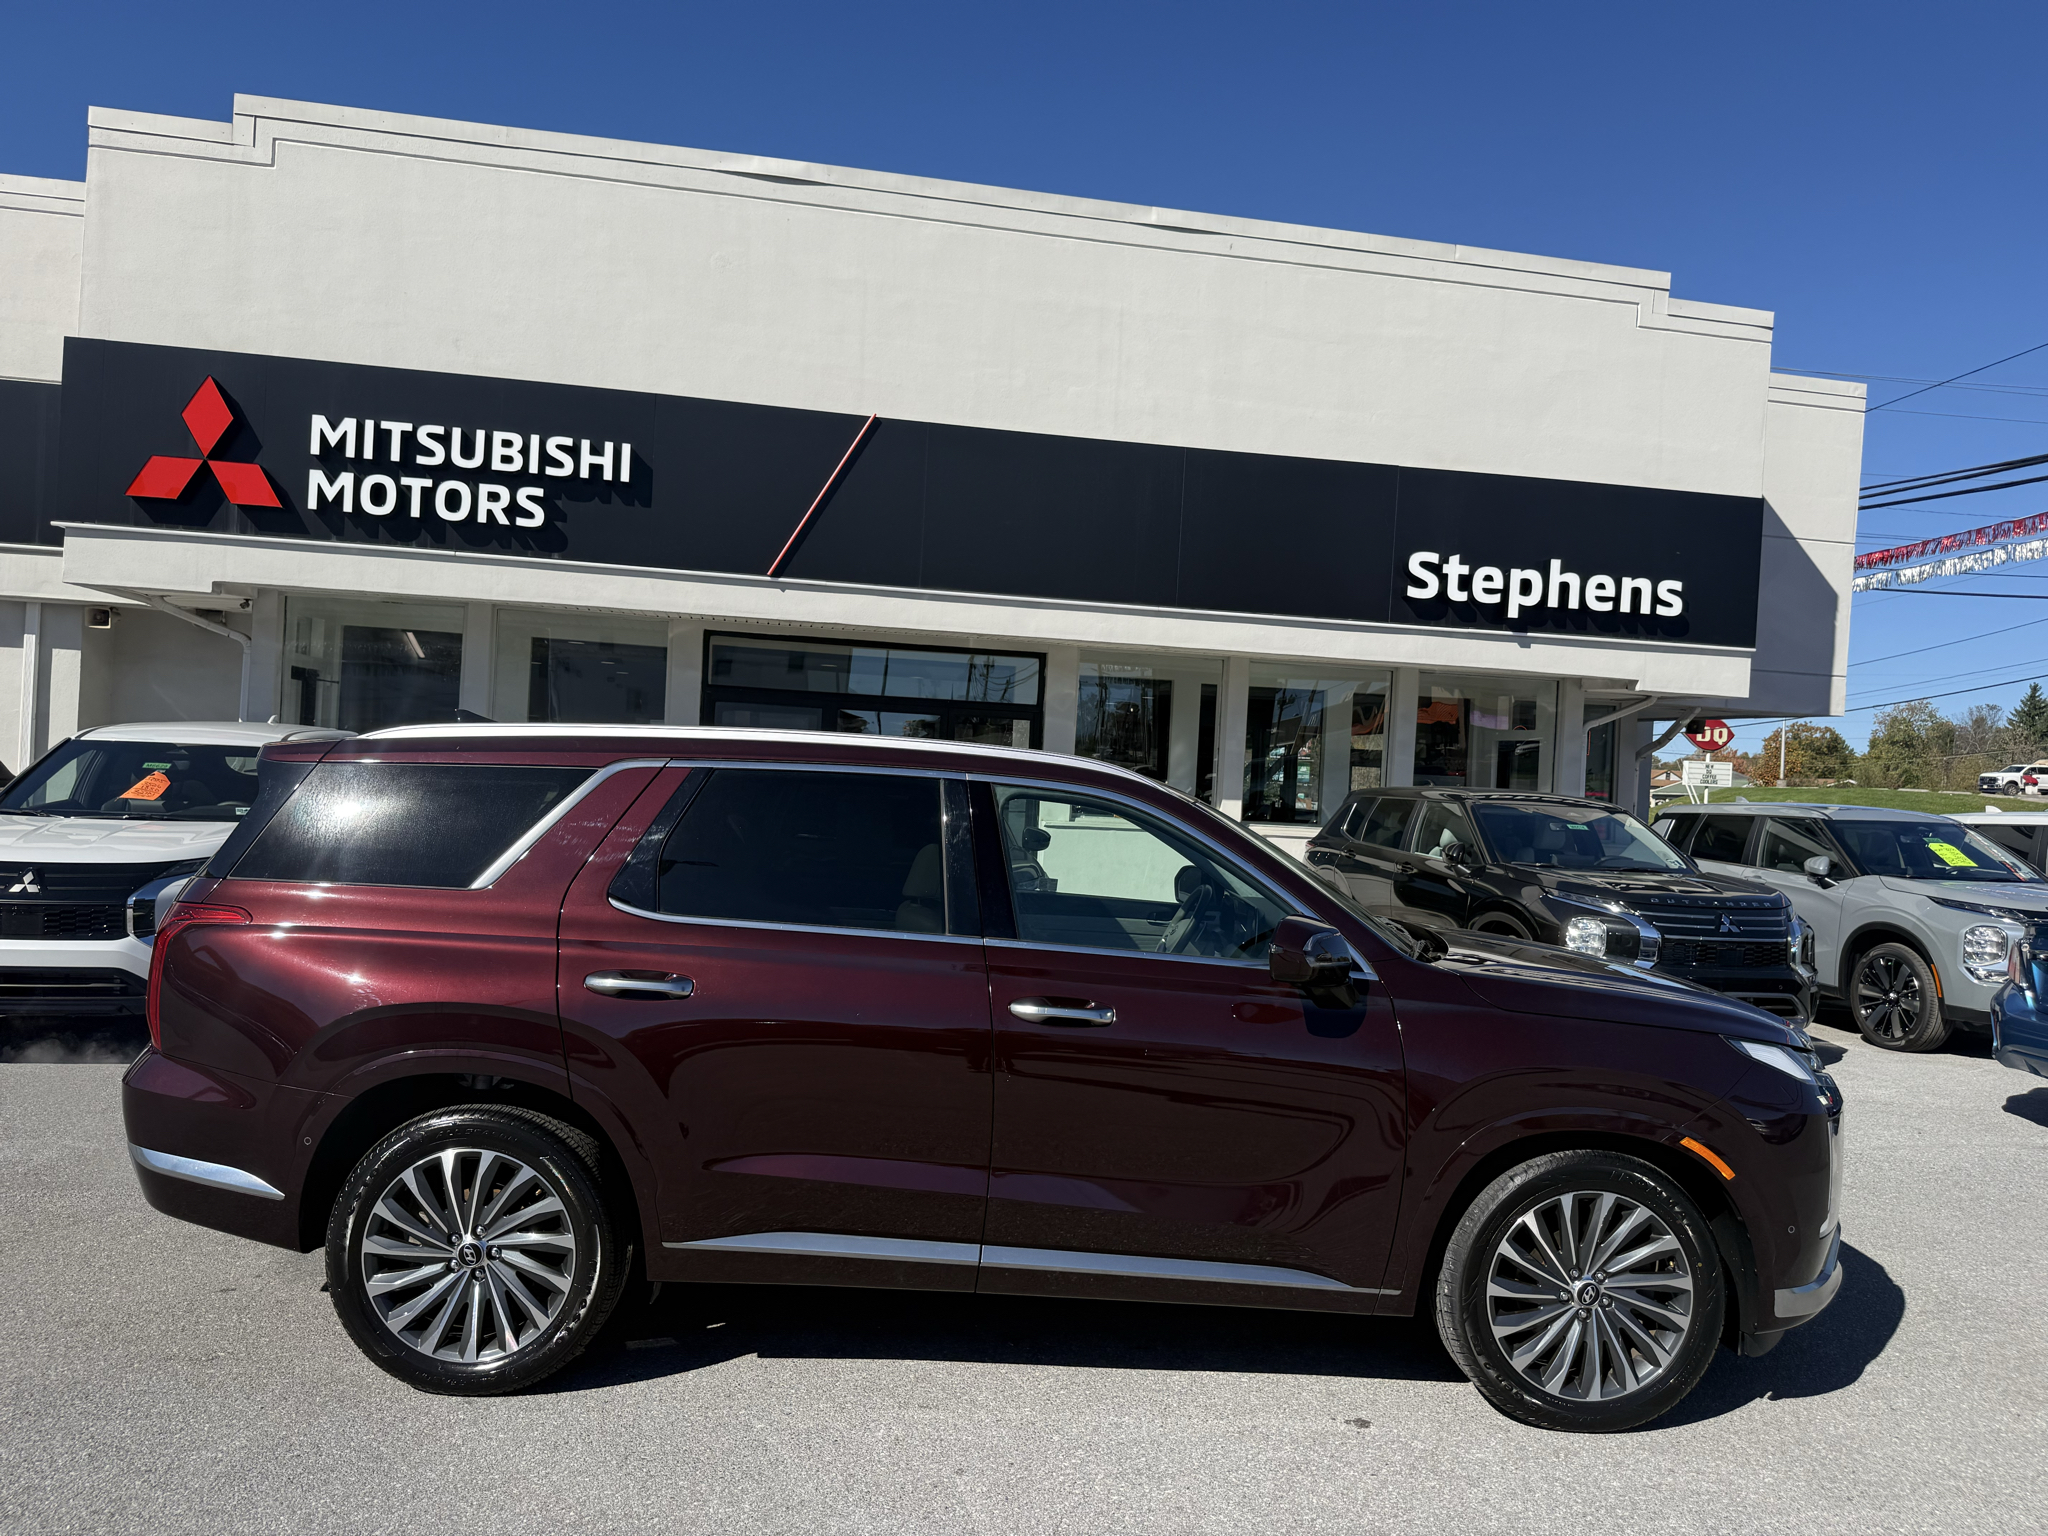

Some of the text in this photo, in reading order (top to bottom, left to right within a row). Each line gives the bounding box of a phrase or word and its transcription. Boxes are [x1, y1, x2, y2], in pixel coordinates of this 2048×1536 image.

[311, 415, 631, 483] MITSUBISHI
[308, 469, 545, 528] MOTORS
[1407, 552, 1683, 619] Stephens
[1696, 726, 1728, 745] DQ
[1650, 897, 1772, 907] OUTLANDER
